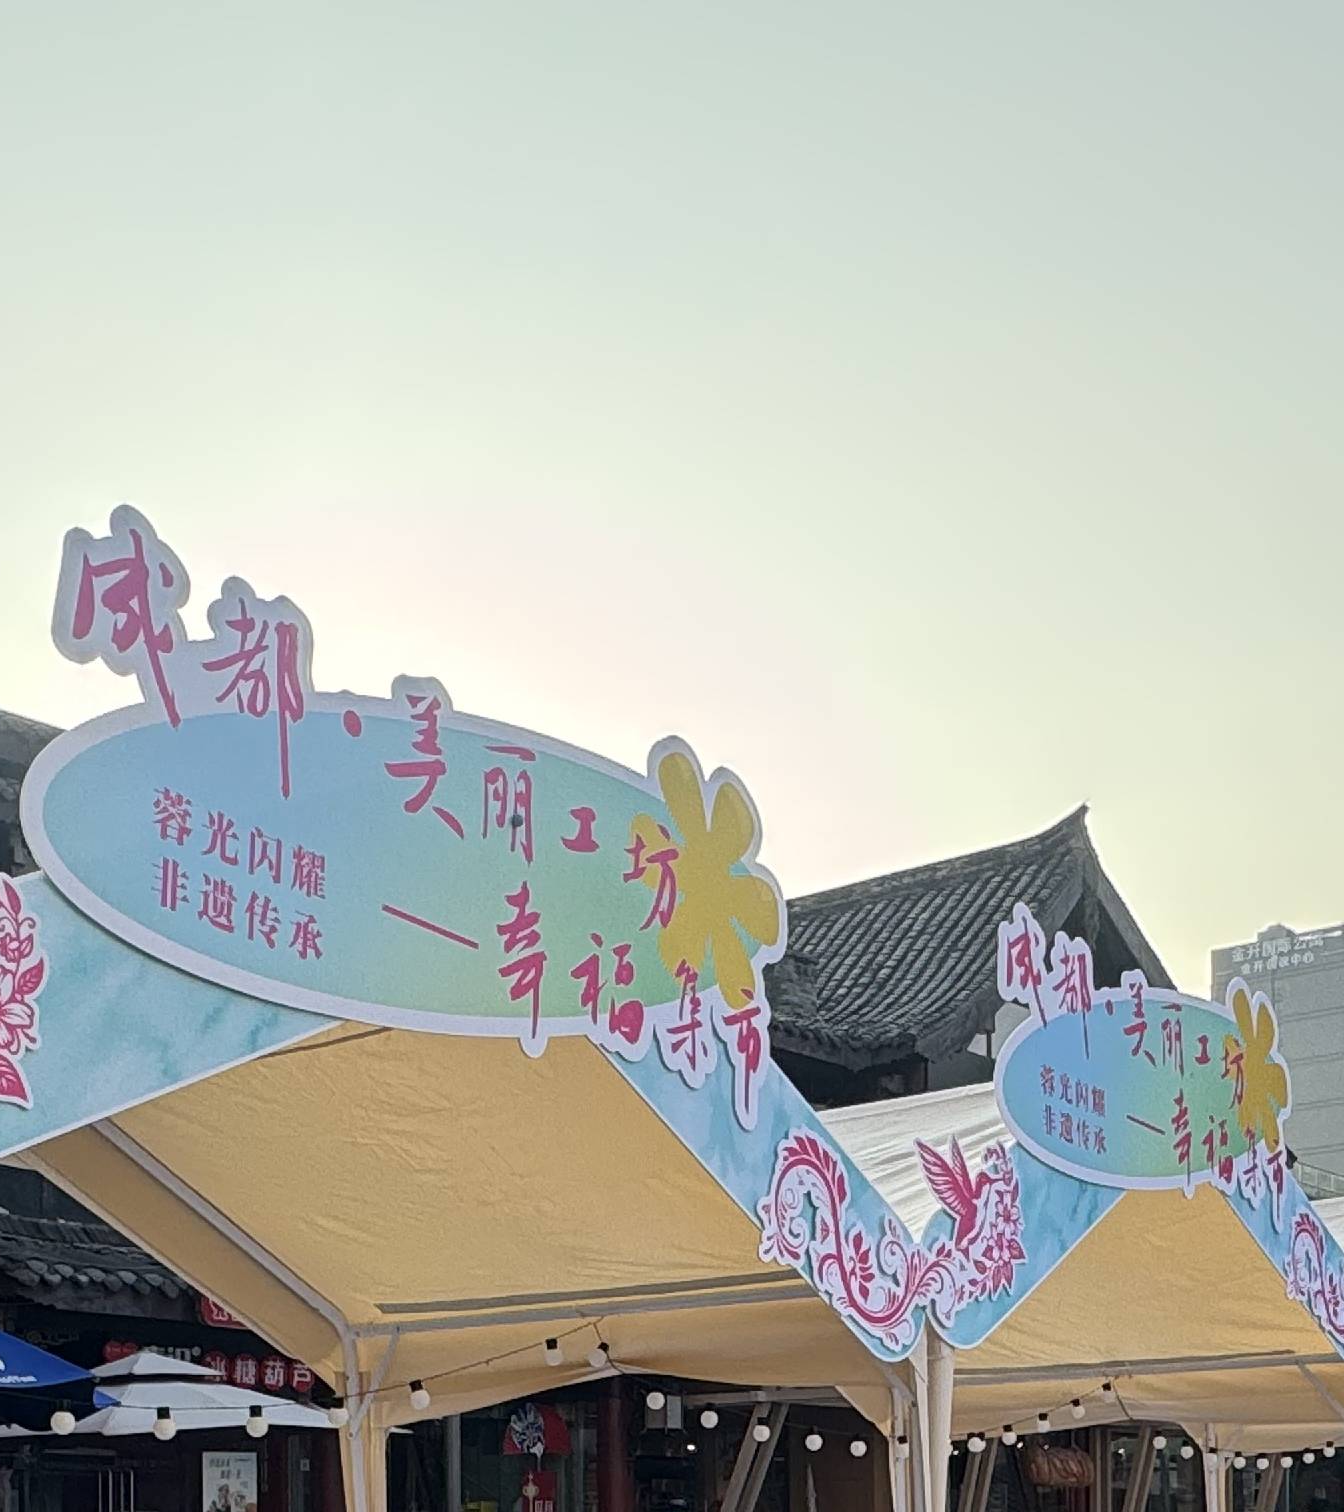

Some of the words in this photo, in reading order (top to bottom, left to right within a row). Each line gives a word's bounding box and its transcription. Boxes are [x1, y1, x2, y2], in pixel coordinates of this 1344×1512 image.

[152, 787, 327, 900] 蓉光闪耀
[151, 858, 325, 961] 非遗传承
